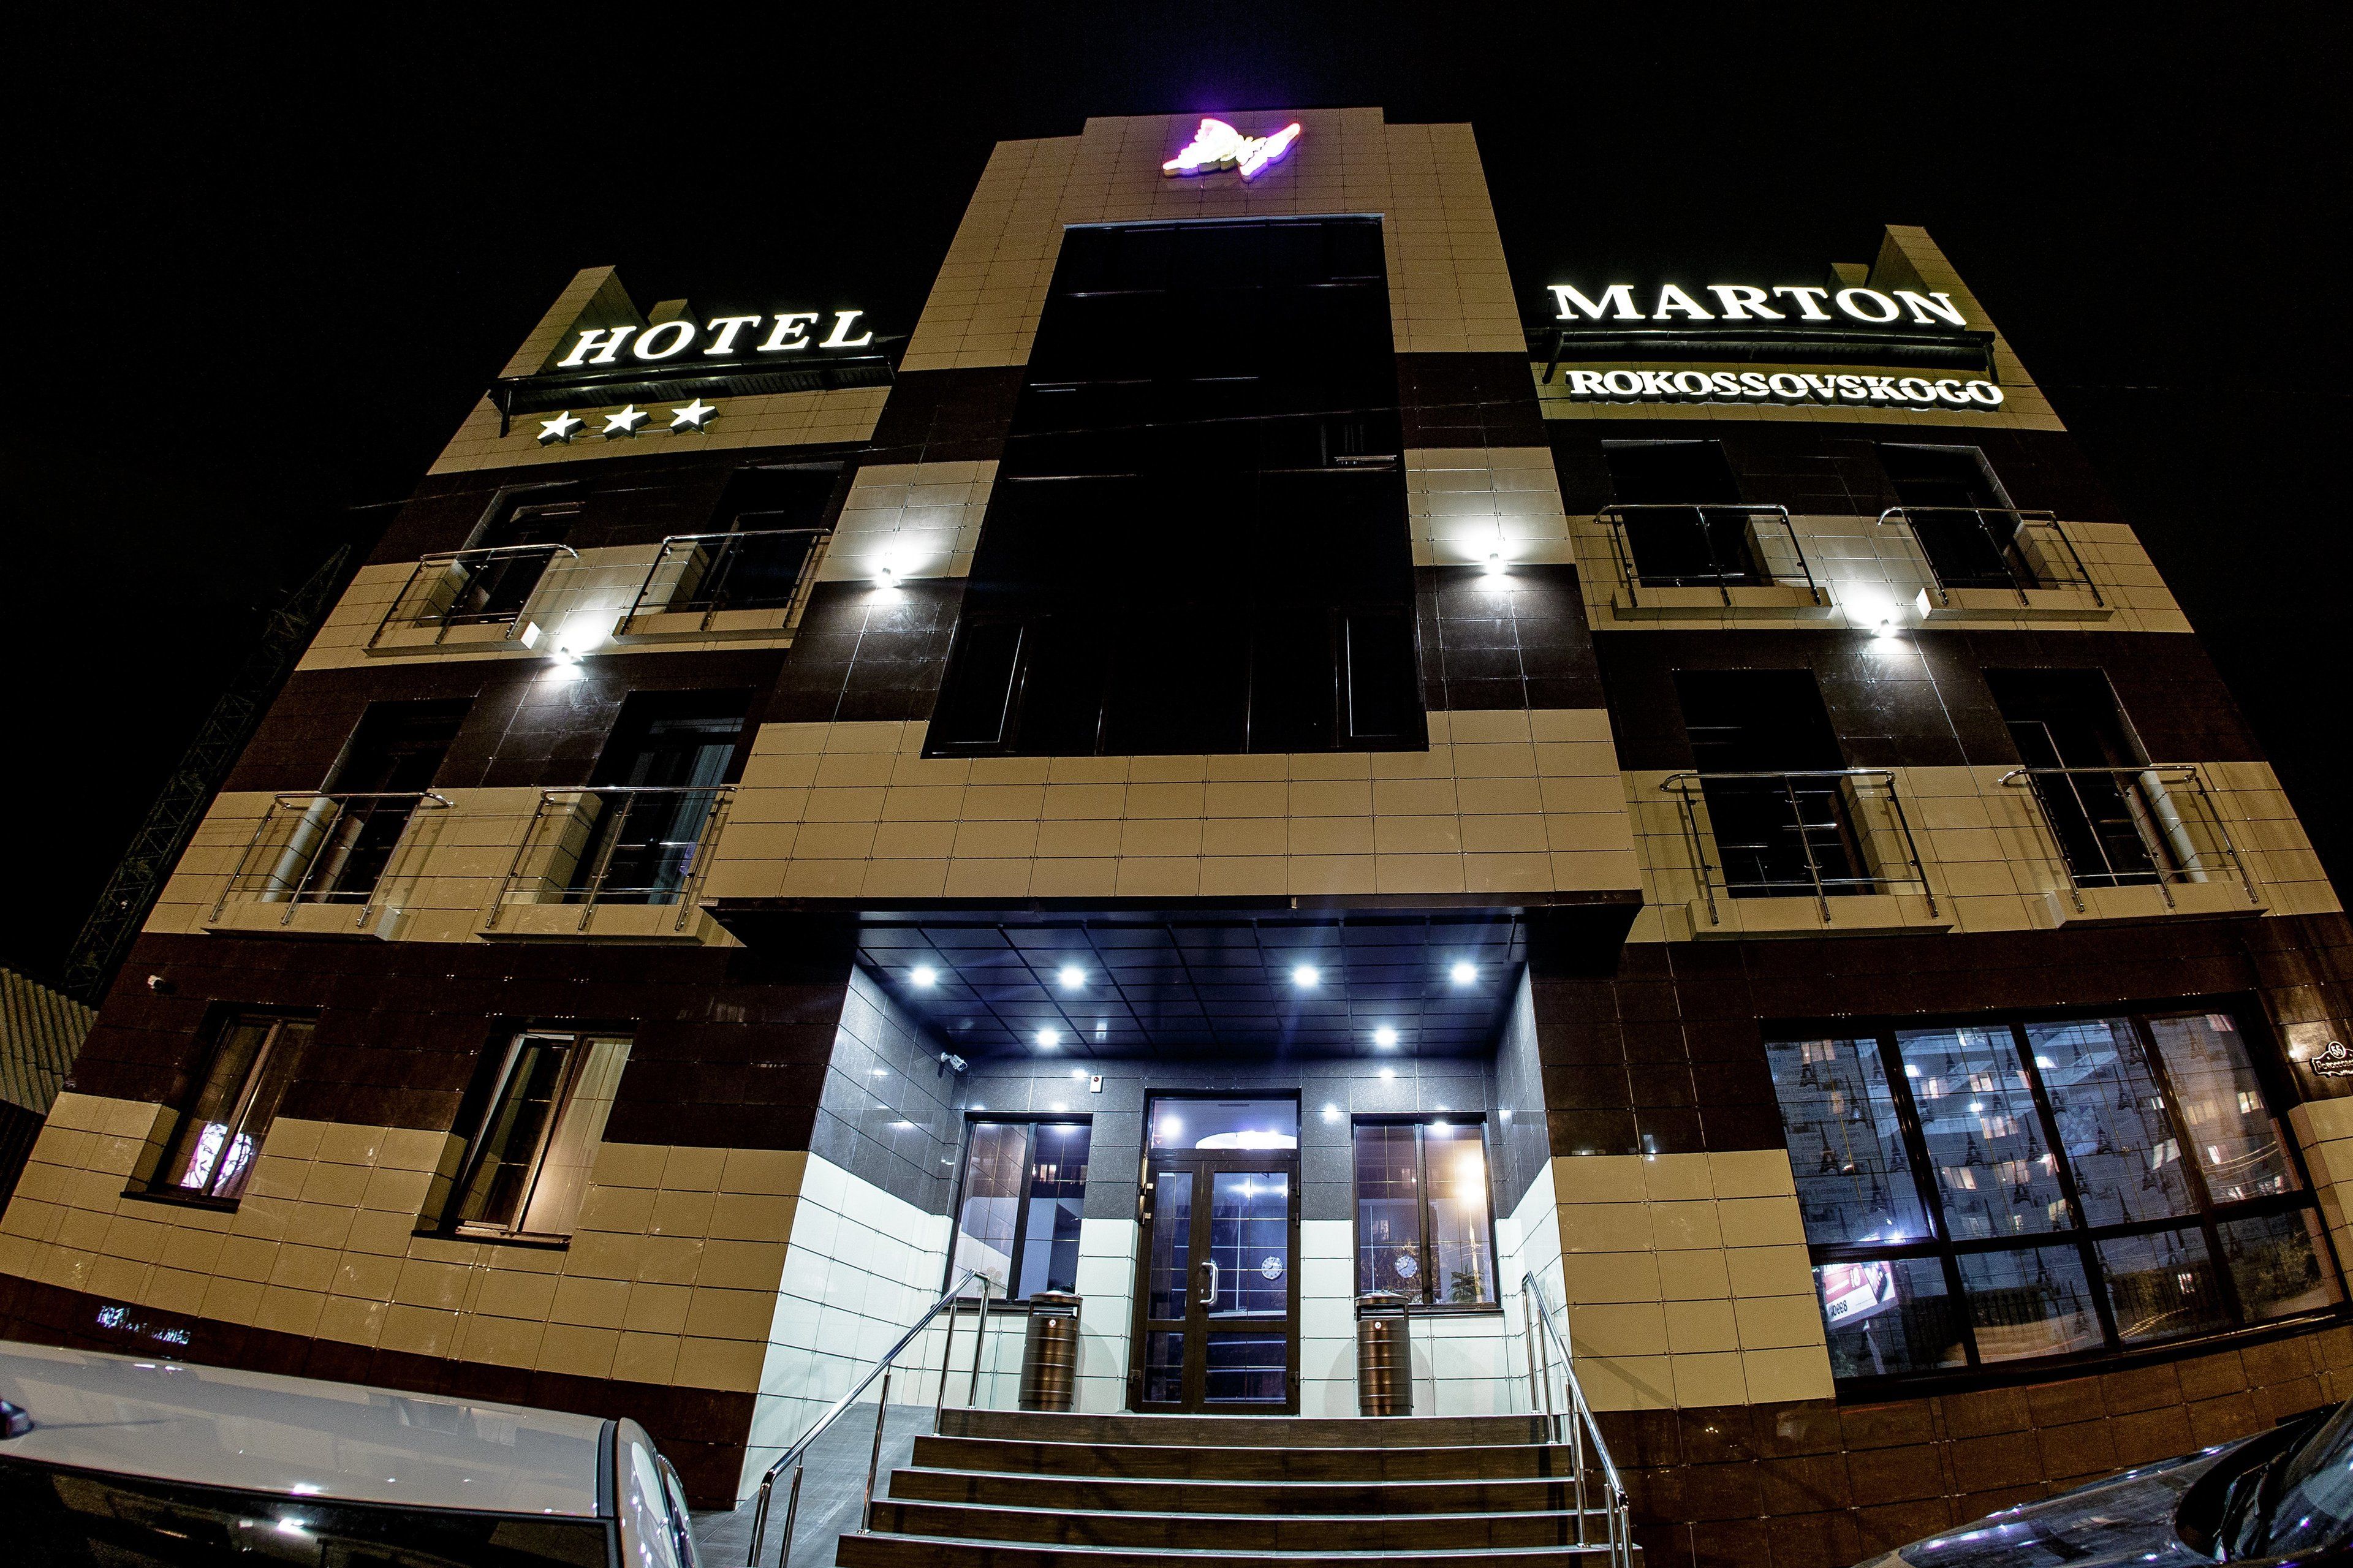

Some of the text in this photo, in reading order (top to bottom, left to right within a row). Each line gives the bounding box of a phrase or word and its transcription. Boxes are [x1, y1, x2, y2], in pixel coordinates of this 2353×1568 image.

[1547, 284, 1967, 325] MARTON
[557, 311, 873, 367] HOTEL
[1566, 370, 2004, 406] ROKOSSOVSKOGO
[2331, 1045, 2343, 1056] 55
